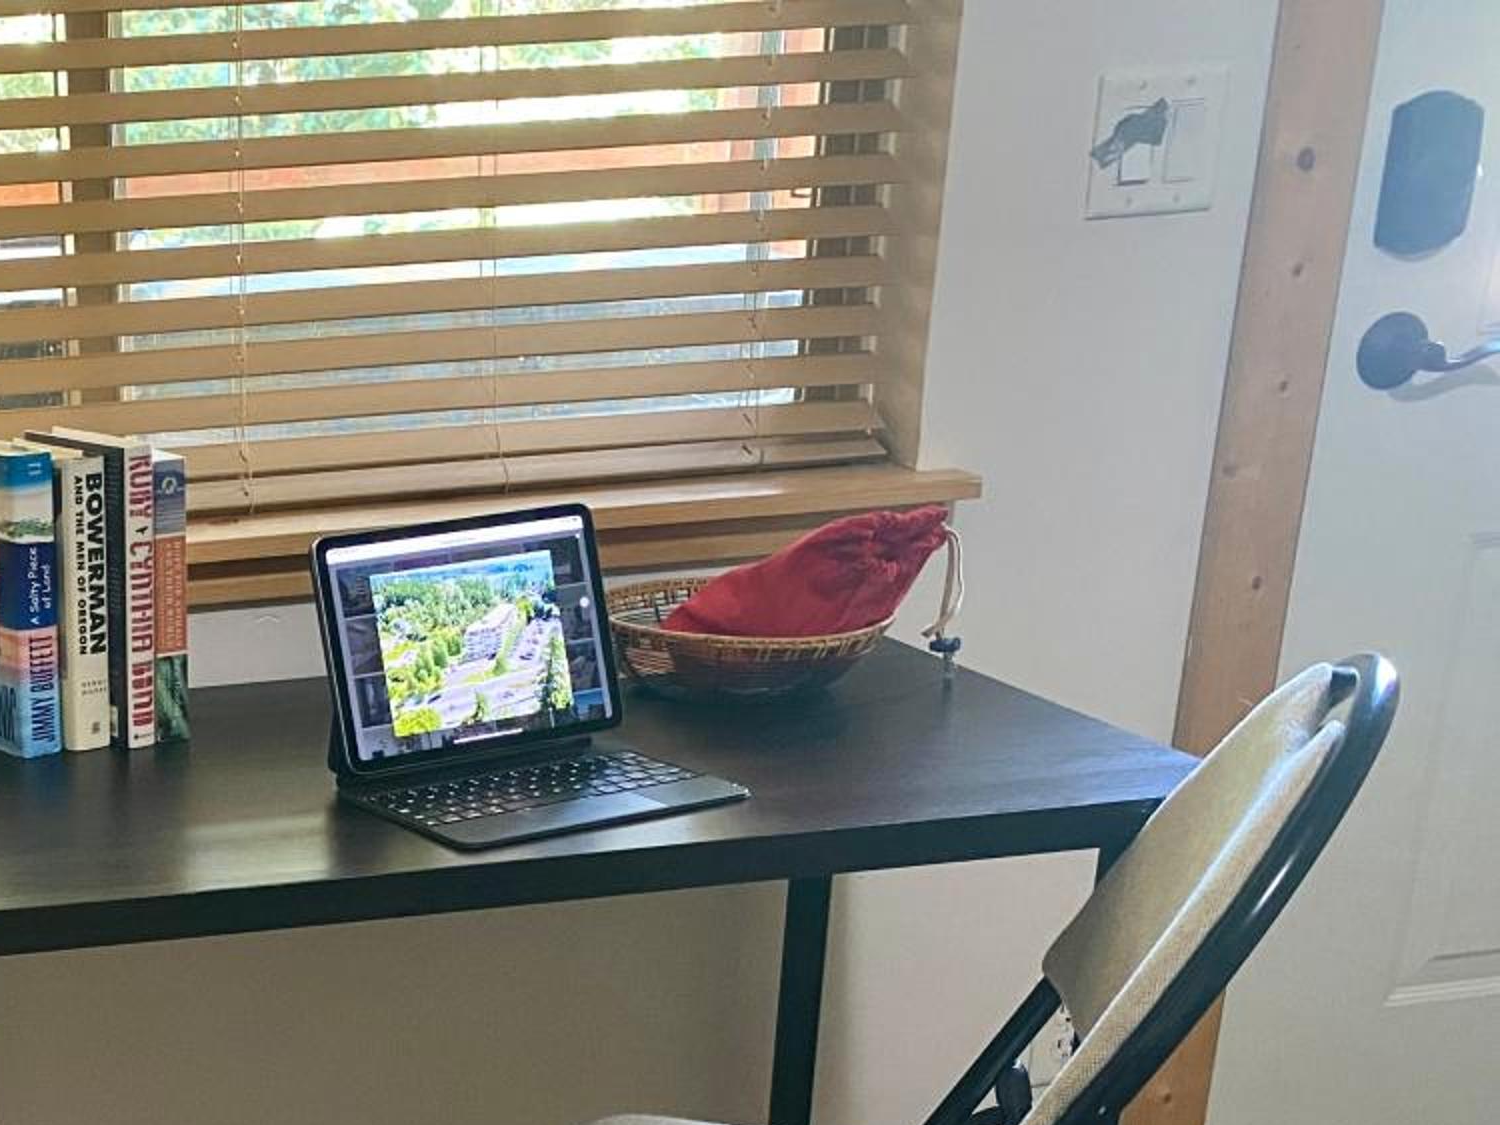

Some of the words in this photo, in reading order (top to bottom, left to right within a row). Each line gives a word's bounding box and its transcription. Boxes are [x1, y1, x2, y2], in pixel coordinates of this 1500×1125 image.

[74, 476, 84, 505] AND
[129, 455, 153, 519] RUBY
[75, 511, 85, 536] THE
[76, 541, 86, 571] MEN
[86, 473, 107, 655] BOWERMAN
[77, 576, 87, 593] OF
[130, 541, 153, 652] CYNTHIA
[30, 616, 40, 626] A
[78, 599, 88, 655] OREGON
[29, 635, 54, 694] BUFFETT
[30, 695, 56, 742] JIMMY
